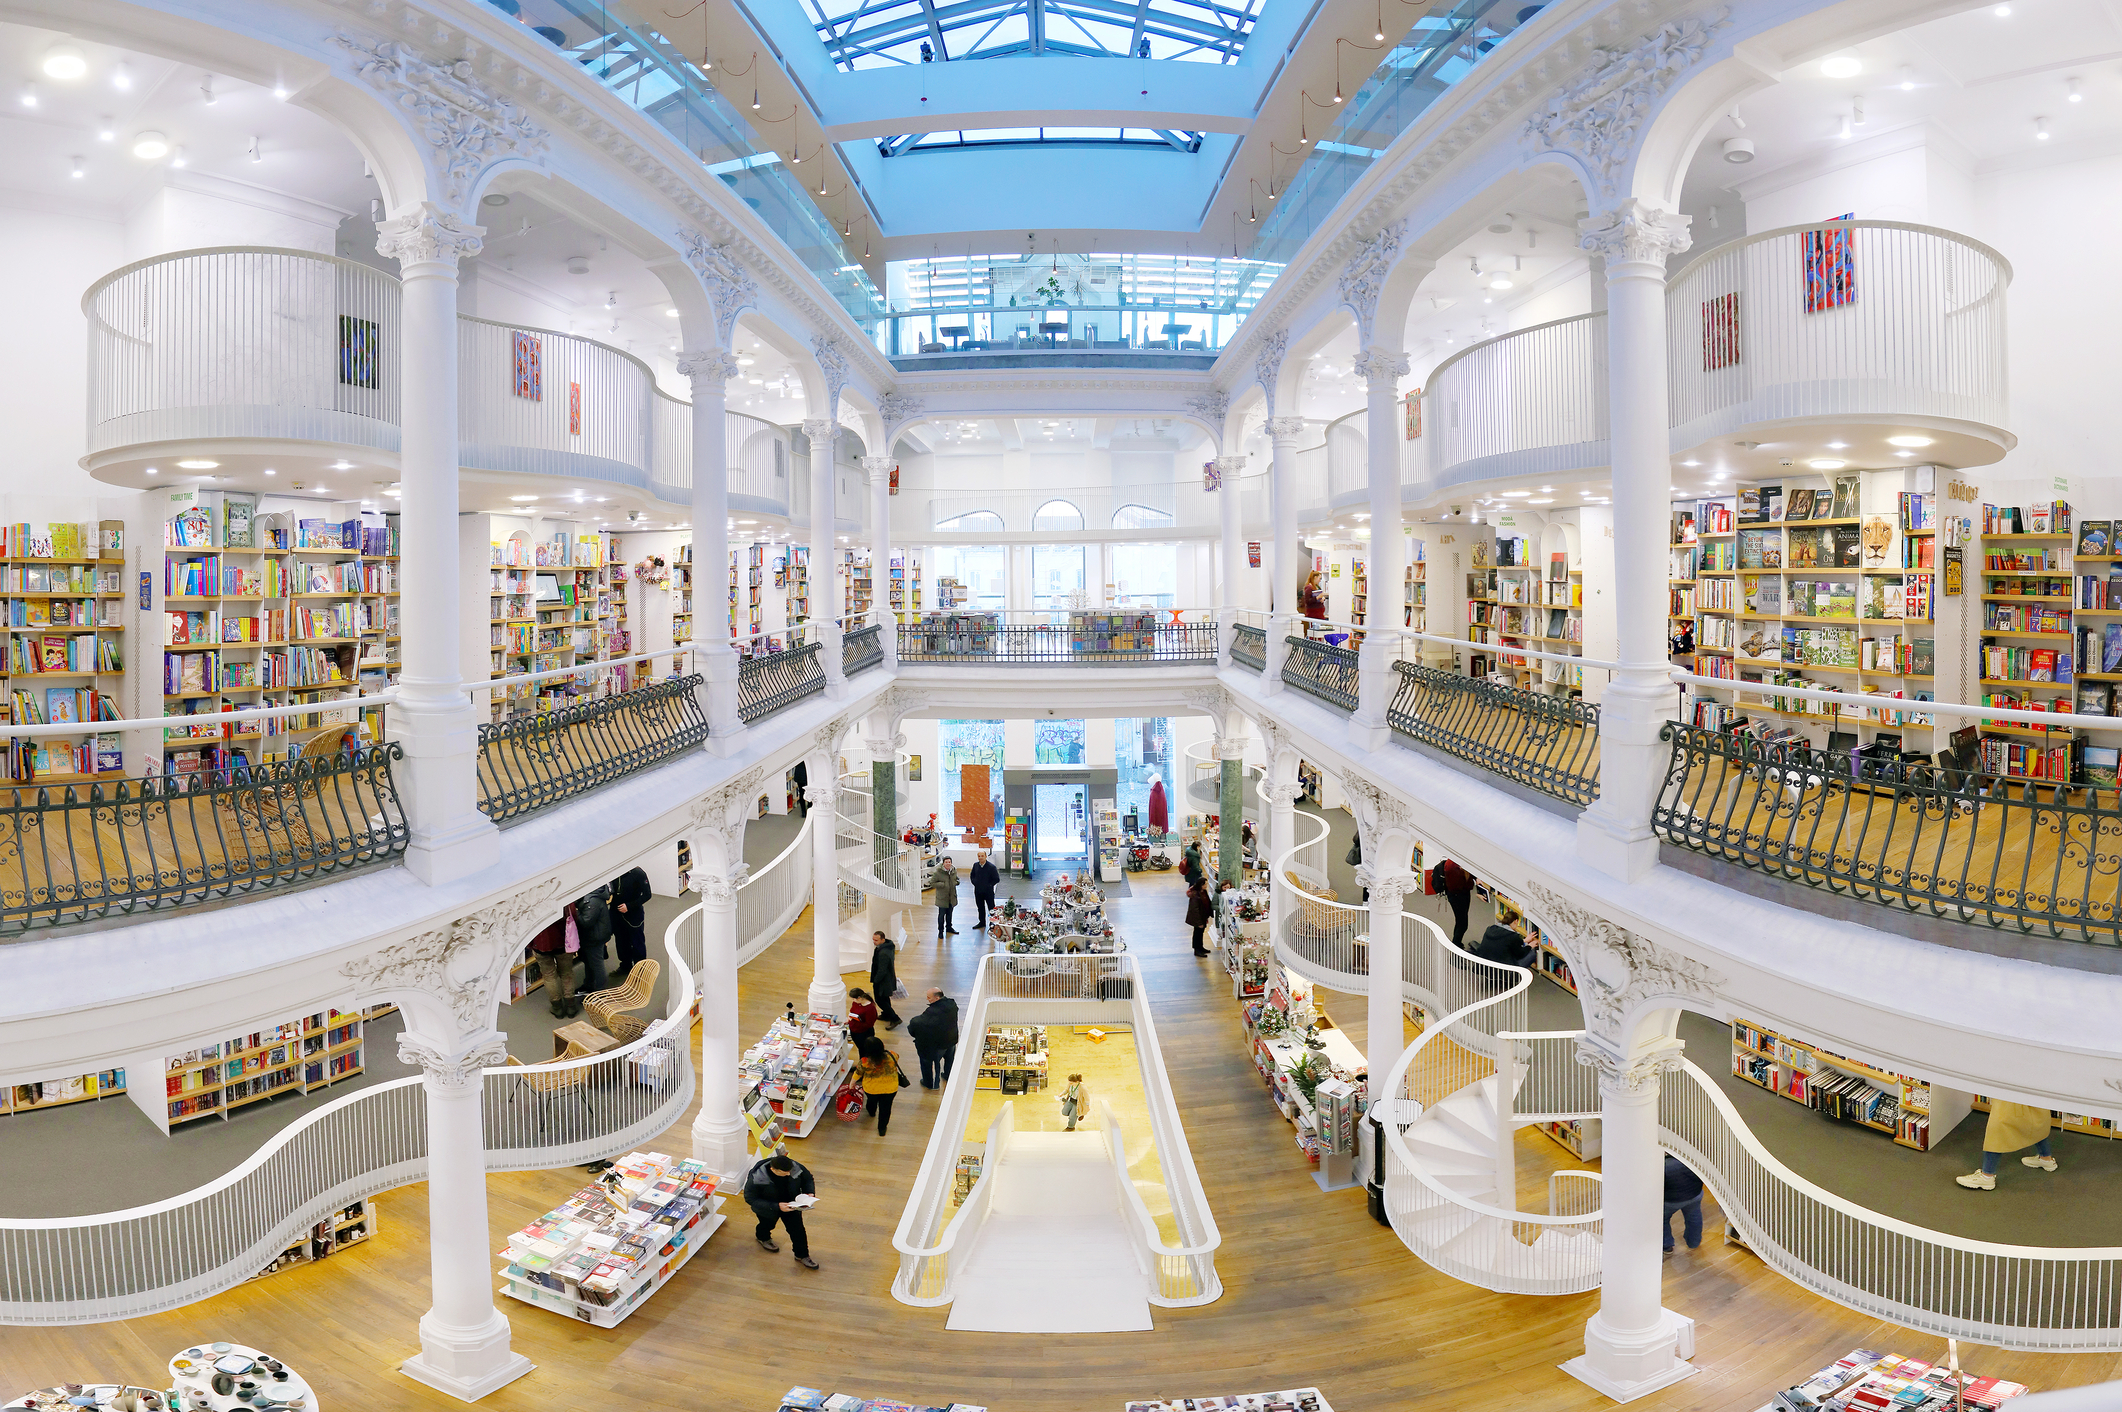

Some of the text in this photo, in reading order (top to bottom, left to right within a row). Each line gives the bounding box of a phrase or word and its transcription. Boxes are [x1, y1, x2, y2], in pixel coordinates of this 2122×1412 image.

[170, 492, 193, 502] FAMILY TIME
[187, 520, 203, 532] 80
[1762, 593, 1779, 602] WAR
